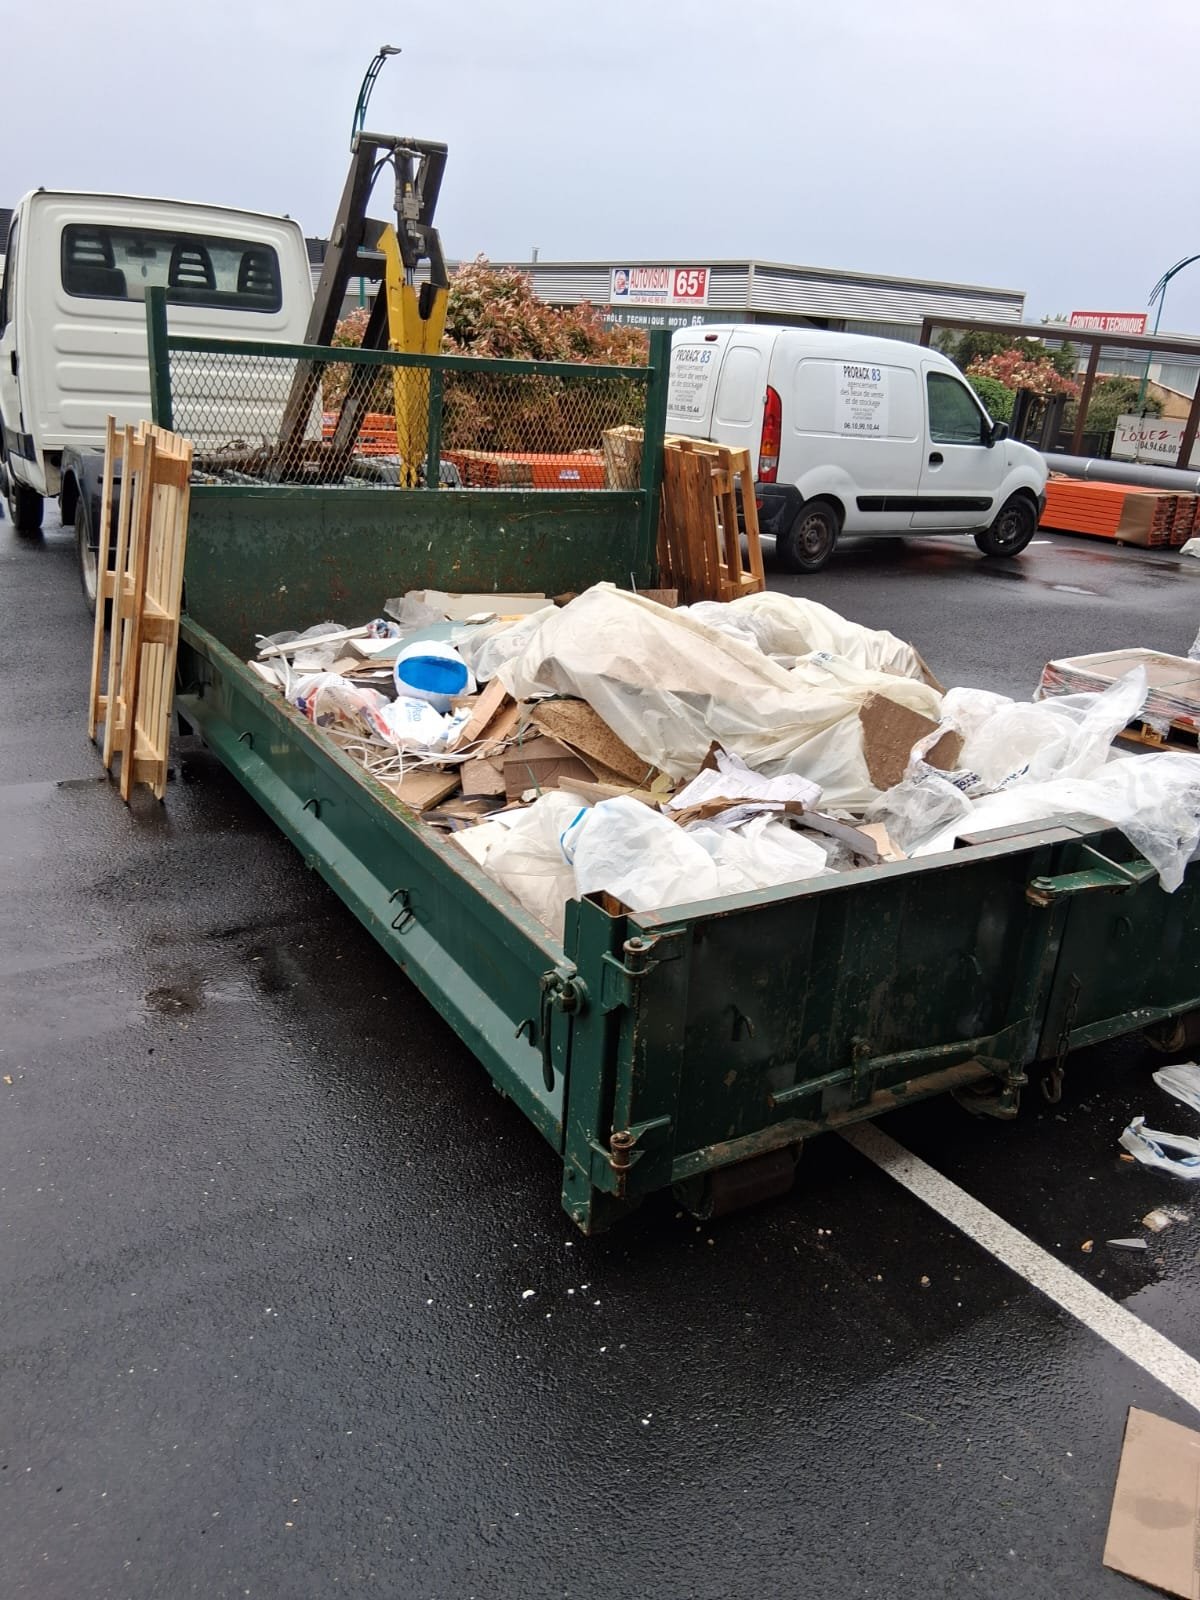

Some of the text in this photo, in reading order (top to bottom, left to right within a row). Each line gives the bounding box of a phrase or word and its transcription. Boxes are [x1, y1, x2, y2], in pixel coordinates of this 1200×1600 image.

[630, 268, 670, 289] AUTOVISION
[627, 315, 664, 325] TECHNIQUE
[668, 317, 687, 326] MOTO
[1105, 317, 1145, 333] TECHNIQUE
[676, 349, 712, 363] PRORACK 83
[843, 365, 881, 381] PRORACK 83
